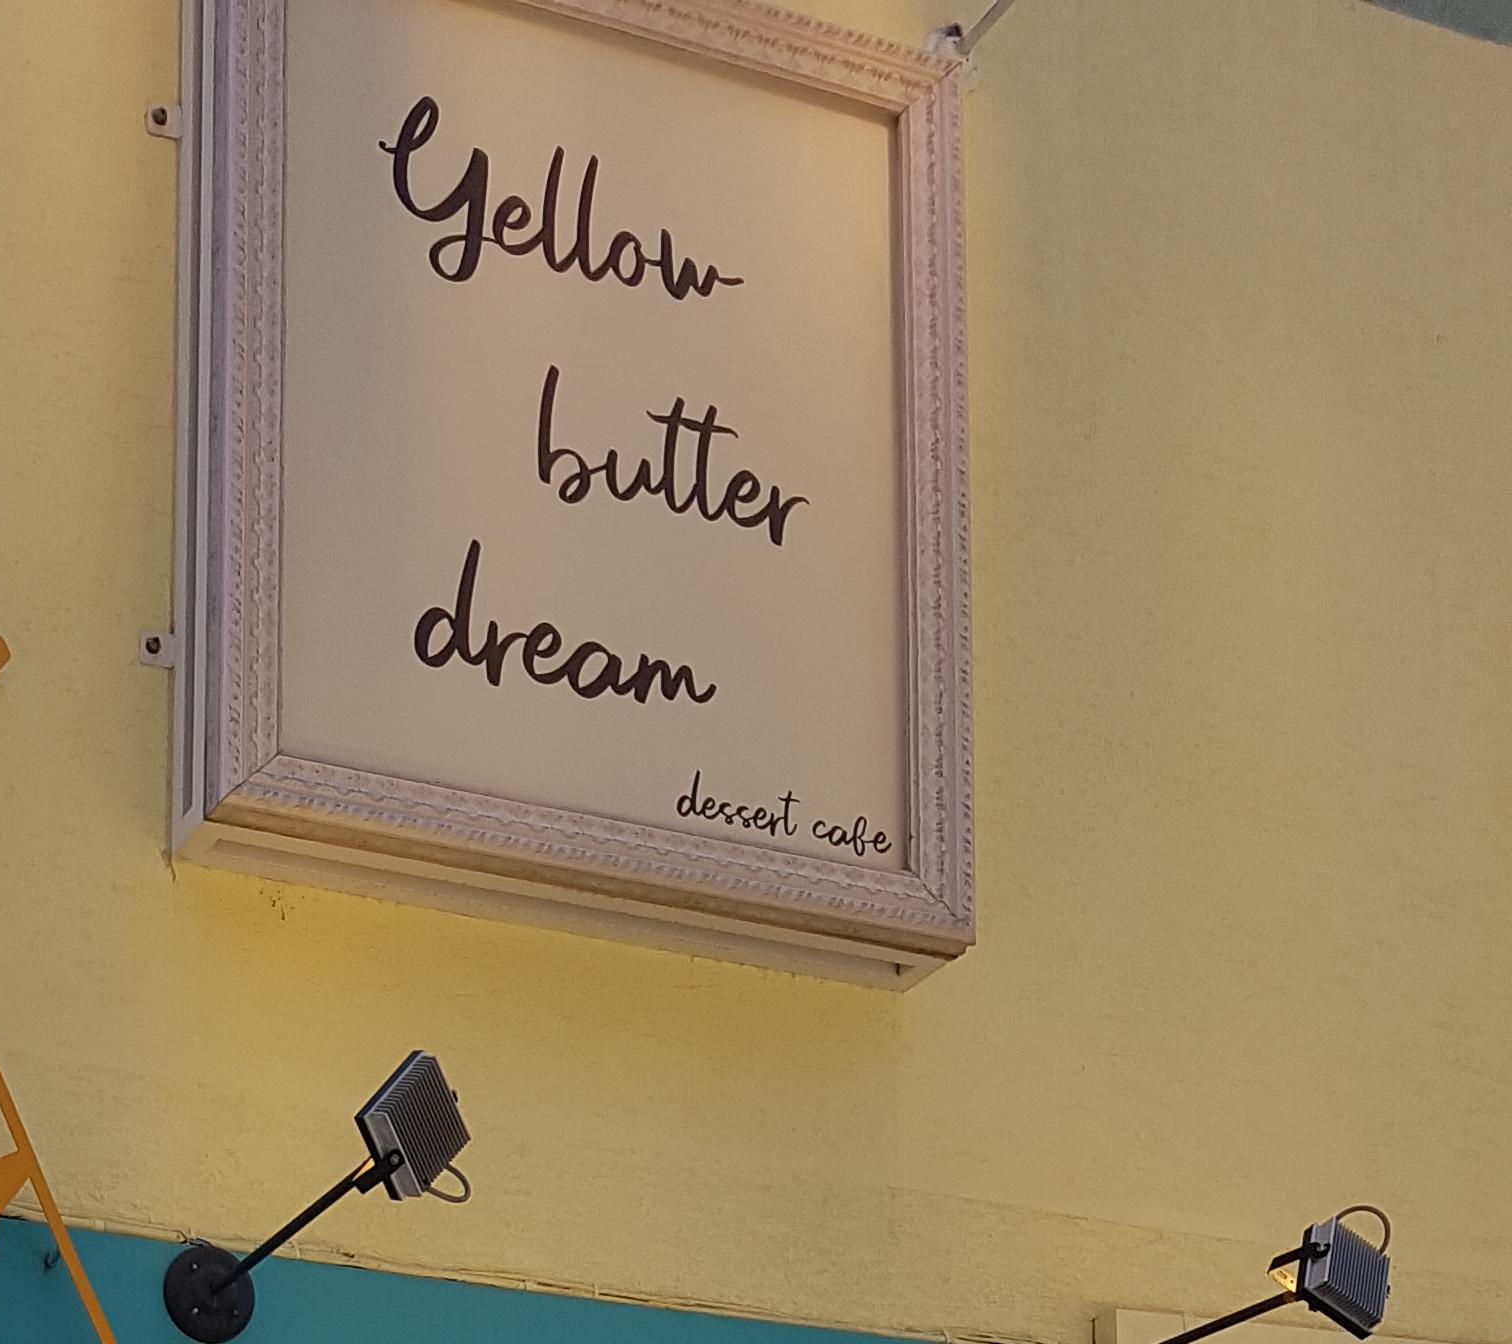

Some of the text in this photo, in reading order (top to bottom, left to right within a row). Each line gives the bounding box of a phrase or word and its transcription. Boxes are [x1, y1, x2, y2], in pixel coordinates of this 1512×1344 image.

[378, 96, 745, 301] Yellow
[538, 365, 810, 547] butter
[414, 539, 717, 705] dream
[676, 769, 893, 857] dessert cafe
